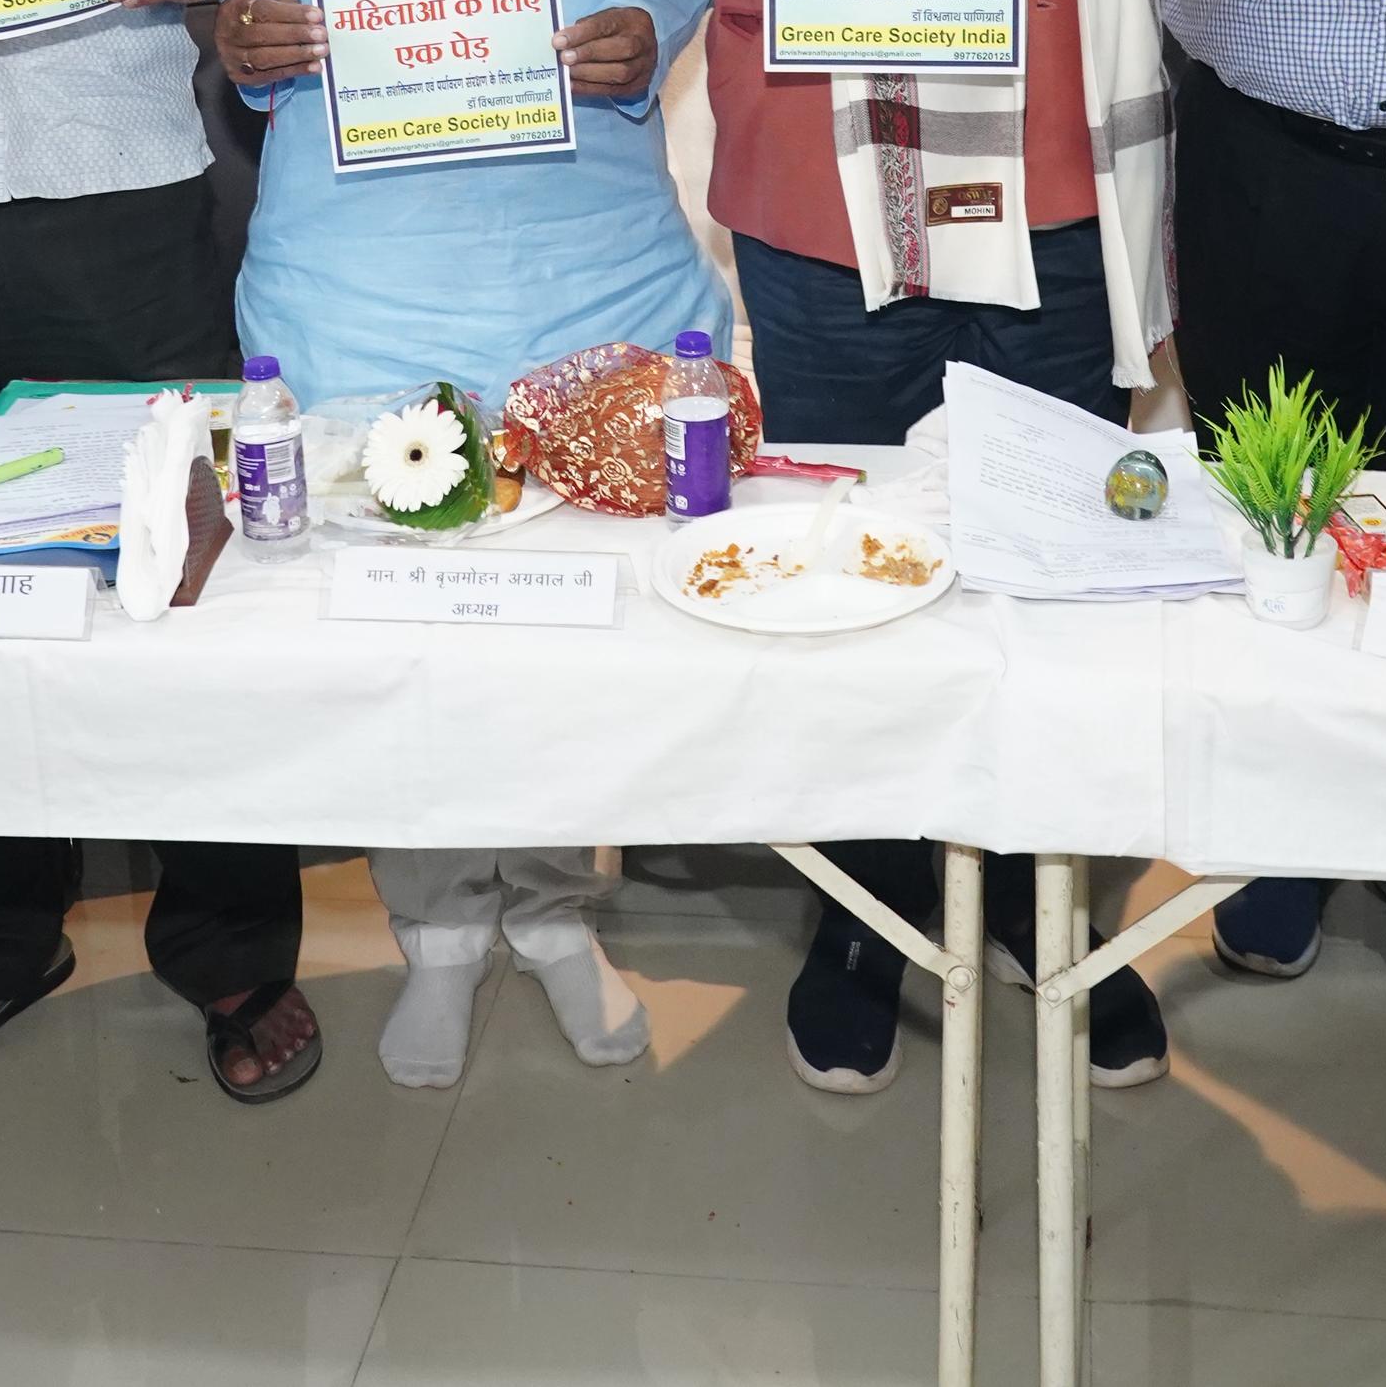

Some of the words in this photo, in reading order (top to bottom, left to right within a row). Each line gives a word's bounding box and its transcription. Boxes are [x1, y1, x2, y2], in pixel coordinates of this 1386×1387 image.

[911, 9, 921, 22] डॉ
[922, 9, 961, 21] विश्वनाथ
[781, 26, 834, 42] Green
[841, 27, 882, 42] Care
[888, 27, 955, 46] Society
[962, 28, 1006, 44] India
[394, 42, 443, 69] एक
[450, 31, 489, 63] पेड़
[953, 51, 1011, 61] 9977620125
[345, 127, 397, 143] Green
[402, 122, 442, 136] Care
[447, 113, 509, 131] Society
[515, 106, 557, 124] India
[964, 207, 994, 215] MOHINI
[409, 567, 425, 583] श्री
[436, 567, 499, 589] बृजमोहन
[508, 572, 564, 587] अग्रवाल
[574, 570, 593, 587] जी
[452, 603, 499, 617] अध्यक्ष
